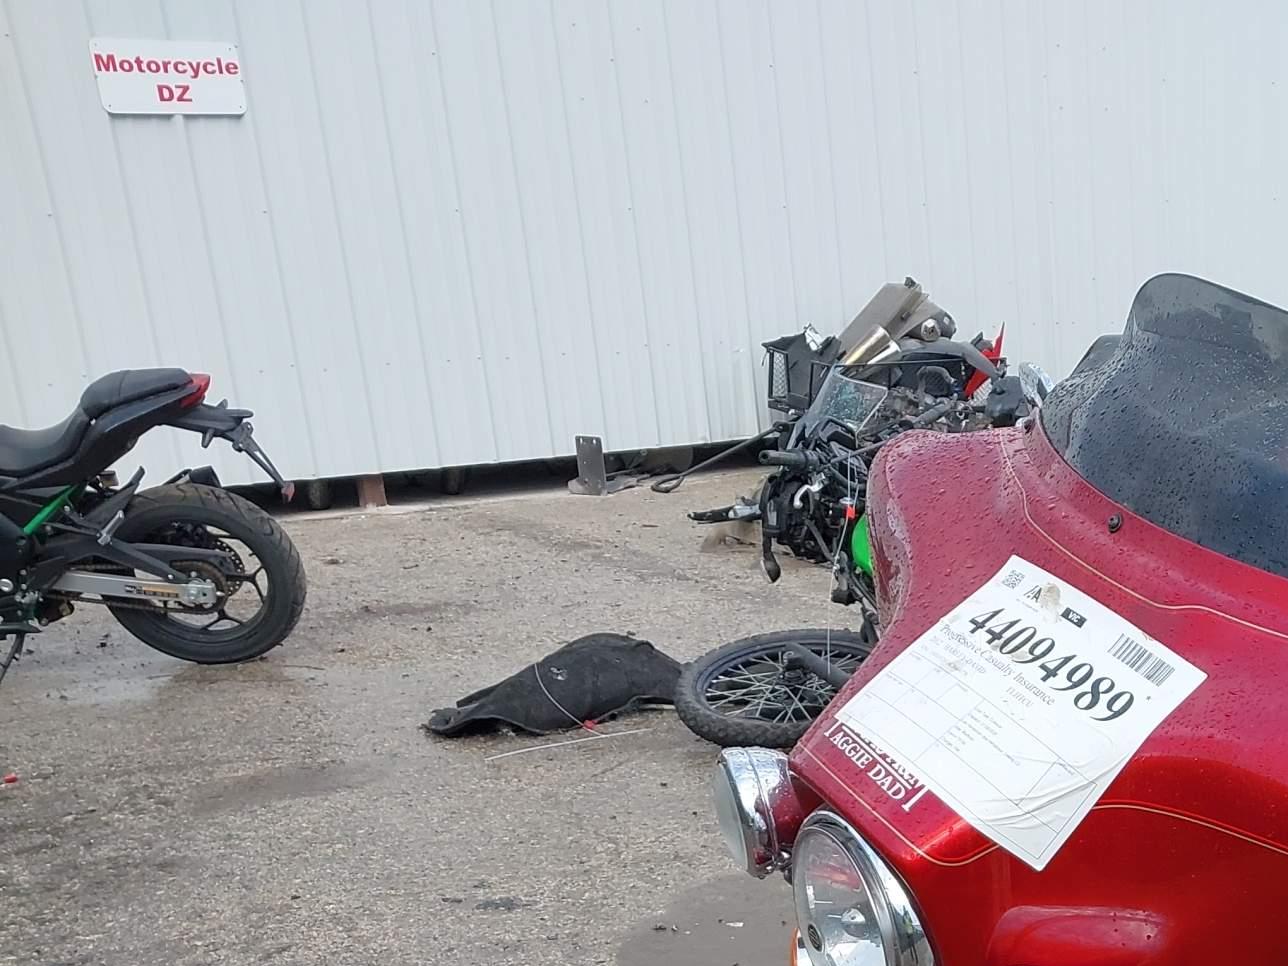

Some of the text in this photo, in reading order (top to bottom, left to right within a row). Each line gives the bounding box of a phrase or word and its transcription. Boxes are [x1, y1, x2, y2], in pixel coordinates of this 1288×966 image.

[93, 53, 240, 79] Motorcycle
[156, 84, 193, 102] DZ
[1067, 610, 1082, 623] VIC
[968, 607, 1135, 722] 44094989
[980, 649, 1014, 678] Casualty
[1012, 671, 1056, 706] Insurance
[829, 729, 873, 769] AGGIE
[867, 762, 906, 800] DAD
